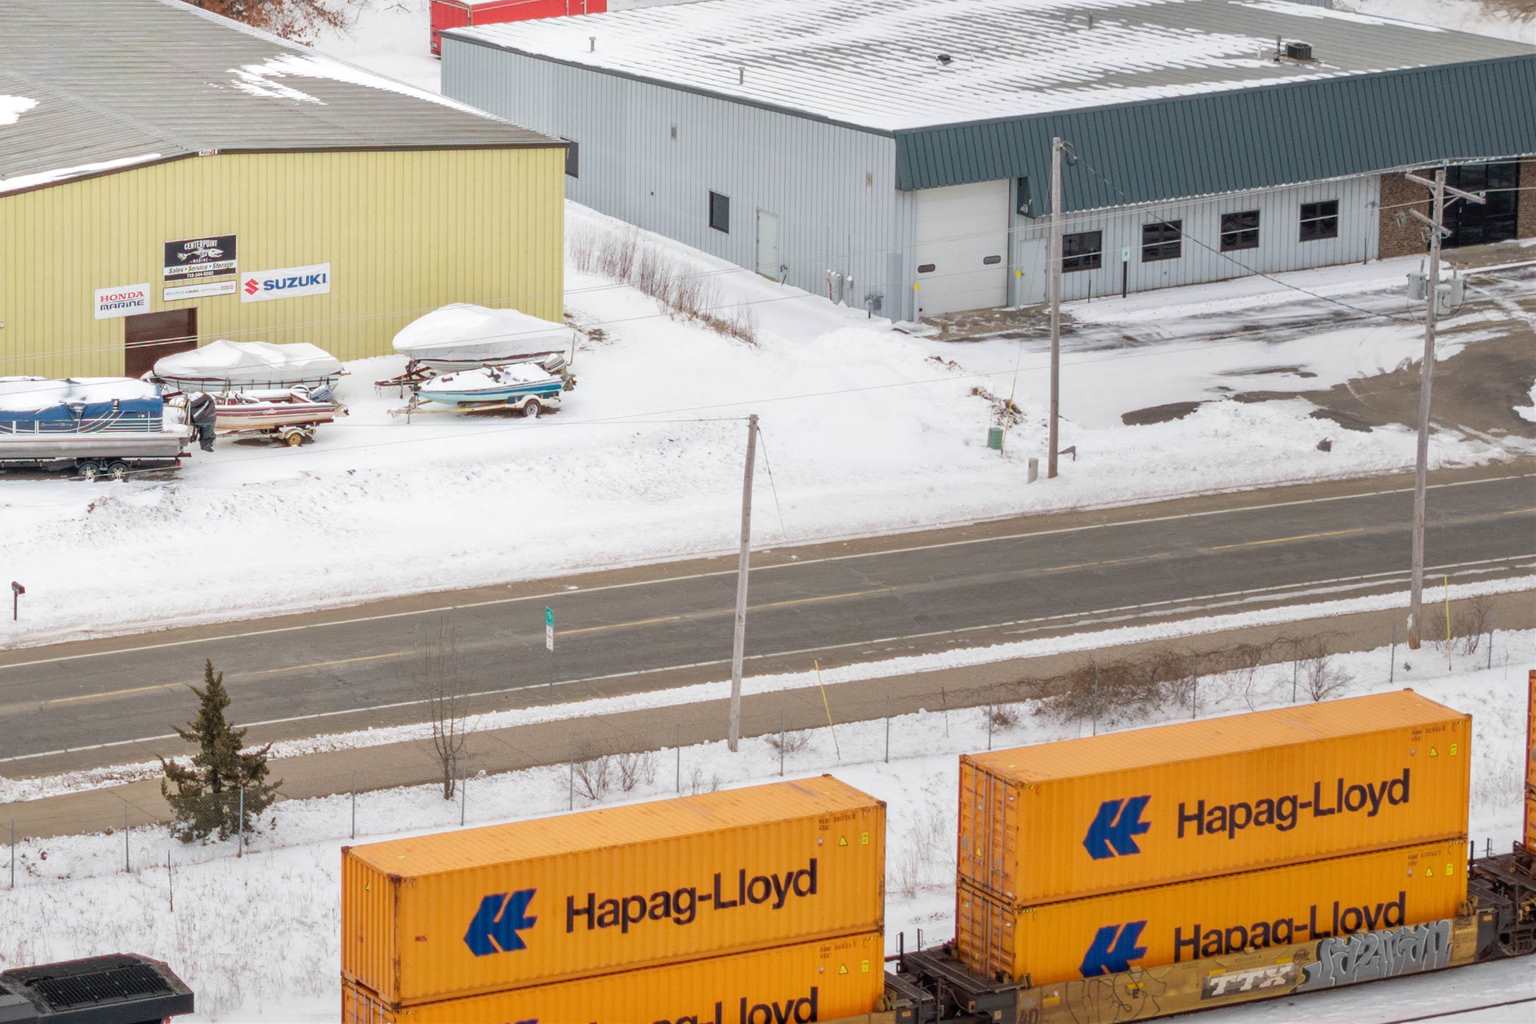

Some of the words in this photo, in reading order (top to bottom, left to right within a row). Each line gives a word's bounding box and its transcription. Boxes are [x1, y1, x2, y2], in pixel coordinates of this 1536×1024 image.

[100, 290, 145, 303] HONDA
[263, 273, 326, 291] SUZUKI
[1177, 768, 1411, 840] Hapag-Lloyd
[566, 858, 818, 934] Hapag-Lloyd
[1209, 965, 1294, 996] TTX
